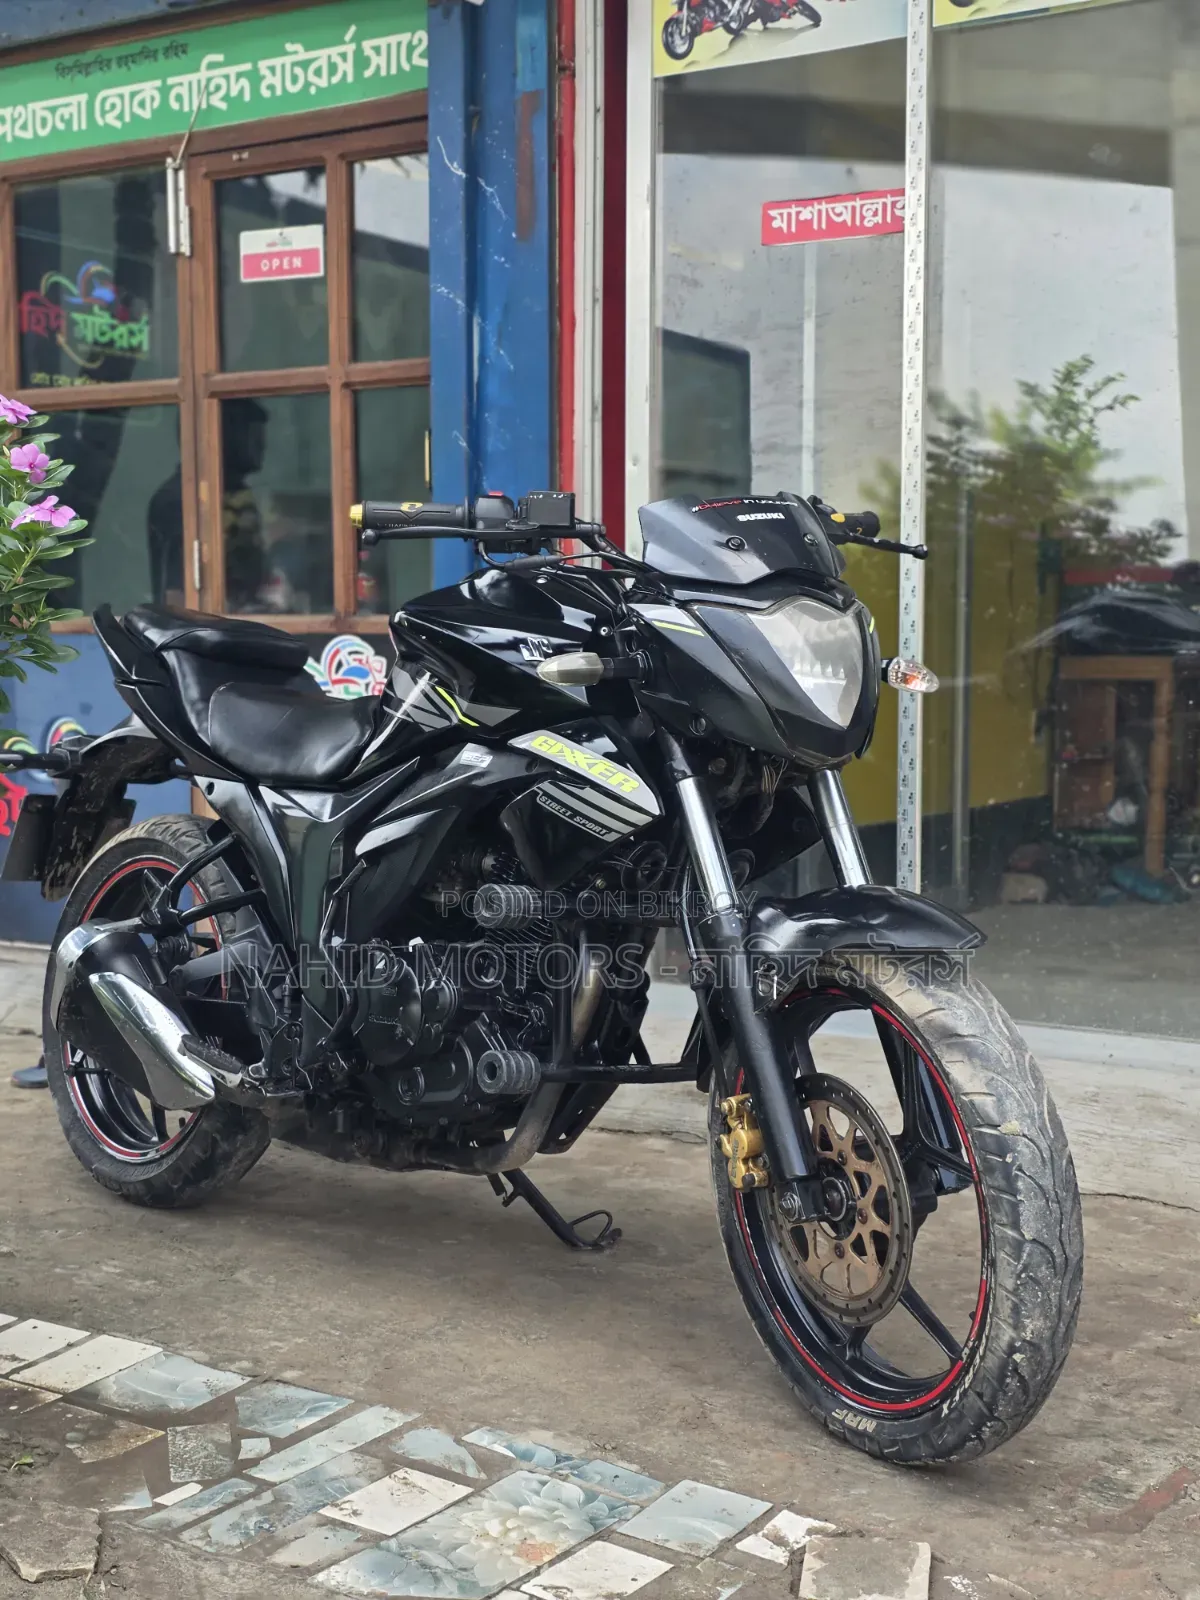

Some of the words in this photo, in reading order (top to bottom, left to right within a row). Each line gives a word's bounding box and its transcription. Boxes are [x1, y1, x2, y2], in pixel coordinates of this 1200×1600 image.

[0, 93, 88, 143] পথচলা
[94, 79, 162, 129] হোক
[167, 54, 253, 113] নাহিদ
[257, 24, 357, 98] মটরর্স
[260, 255, 302, 272] OPEN
[737, 512, 785, 522] SUZUKI
[539, 795, 574, 817] STREET
[574, 815, 610, 837] SPORT
[832, 1408, 877, 1433] MRF
